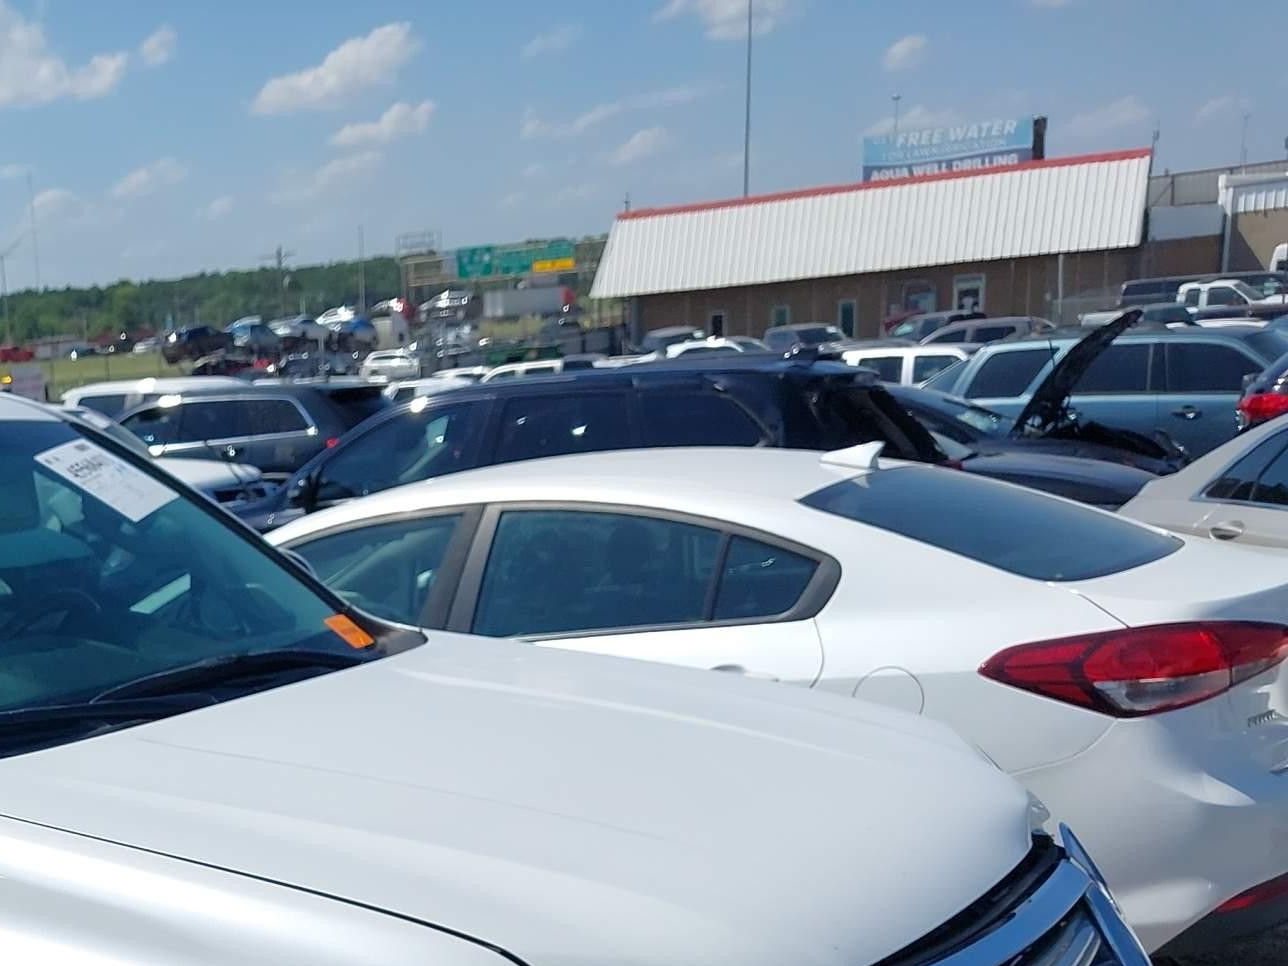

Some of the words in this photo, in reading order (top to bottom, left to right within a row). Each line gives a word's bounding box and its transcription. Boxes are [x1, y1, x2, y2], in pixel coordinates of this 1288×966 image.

[896, 128, 943, 147] FREE
[949, 120, 1017, 141] WATER
[870, 167, 910, 181] AQUA
[913, 162, 947, 177] WELL
[952, 153, 1018, 172] DRILLING
